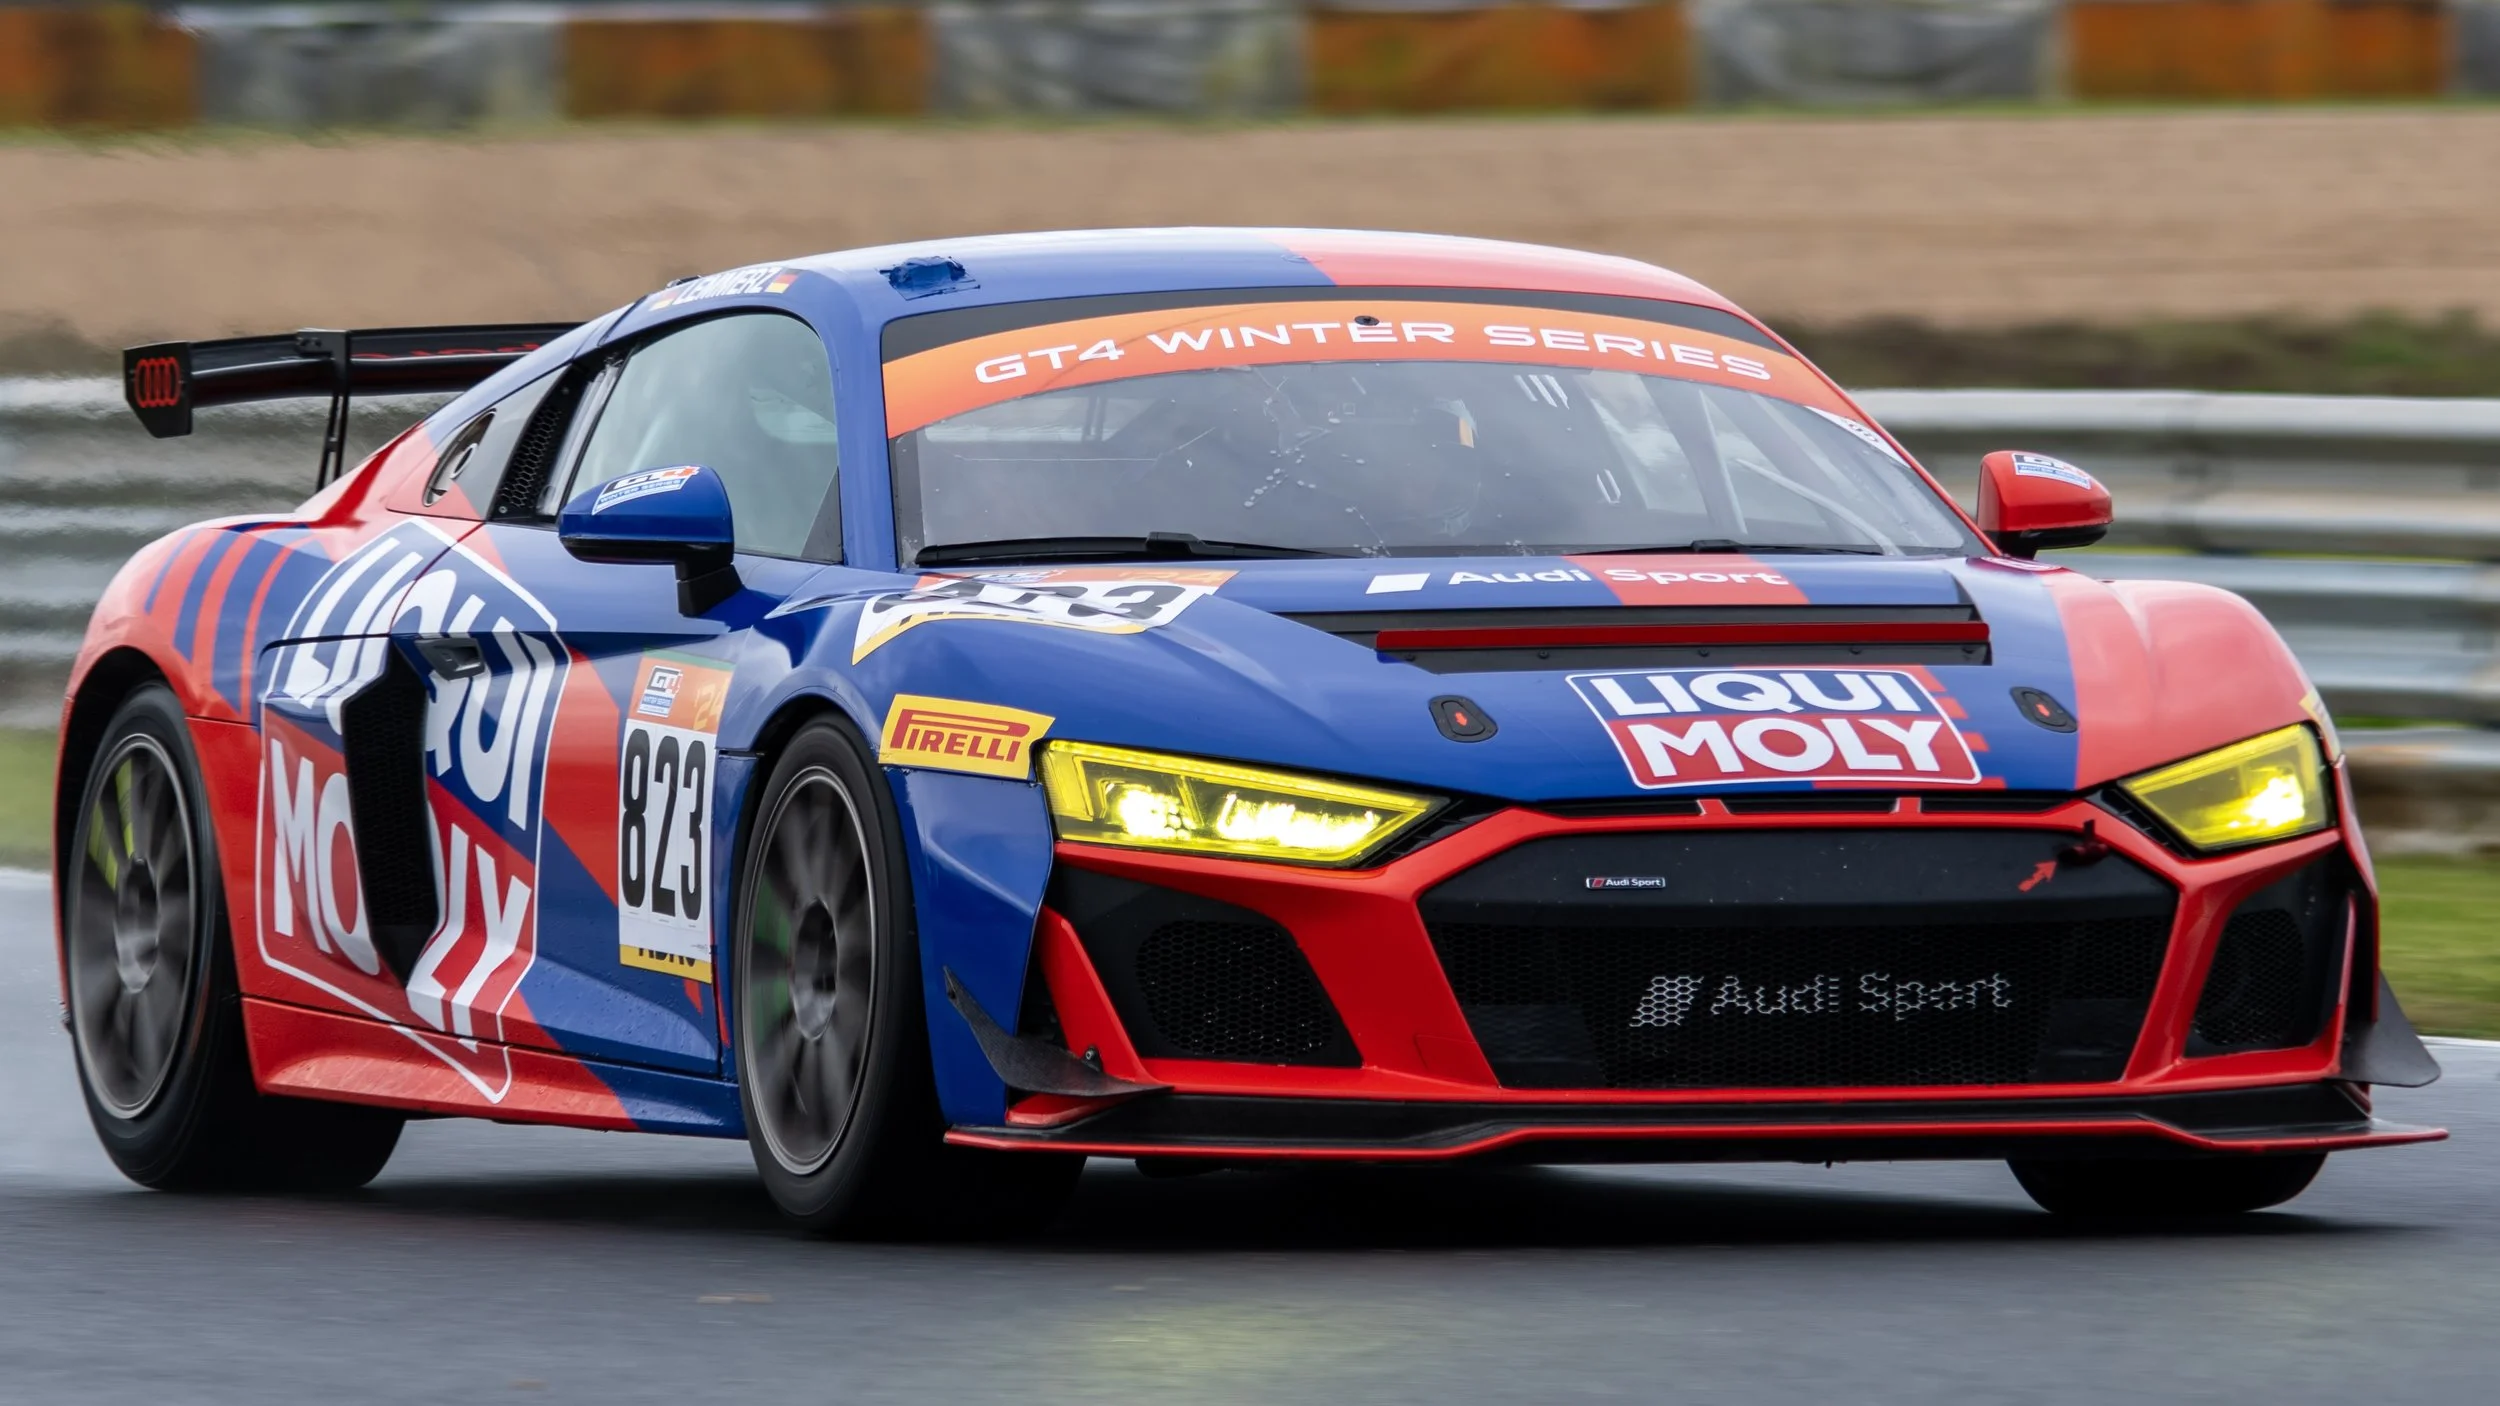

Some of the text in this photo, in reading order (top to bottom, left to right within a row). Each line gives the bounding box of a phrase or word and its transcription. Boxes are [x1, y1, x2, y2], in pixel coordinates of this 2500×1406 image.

[975, 322, 1771, 383] GT4 WINTER SERIES
[1447, 569, 1790, 586] Audi Sport
[285, 537, 556, 830] LIQUI
[1590, 672, 1922, 714] LIQUI
[890, 709, 1031, 762] PIRELLI
[1627, 718, 1942, 778] MOLY
[621, 728, 706, 921] 823
[271, 738, 531, 1052] MOLY
[1605, 878, 1661, 887] Audi Sport
[1711, 973, 2012, 1021] Audi Sport
